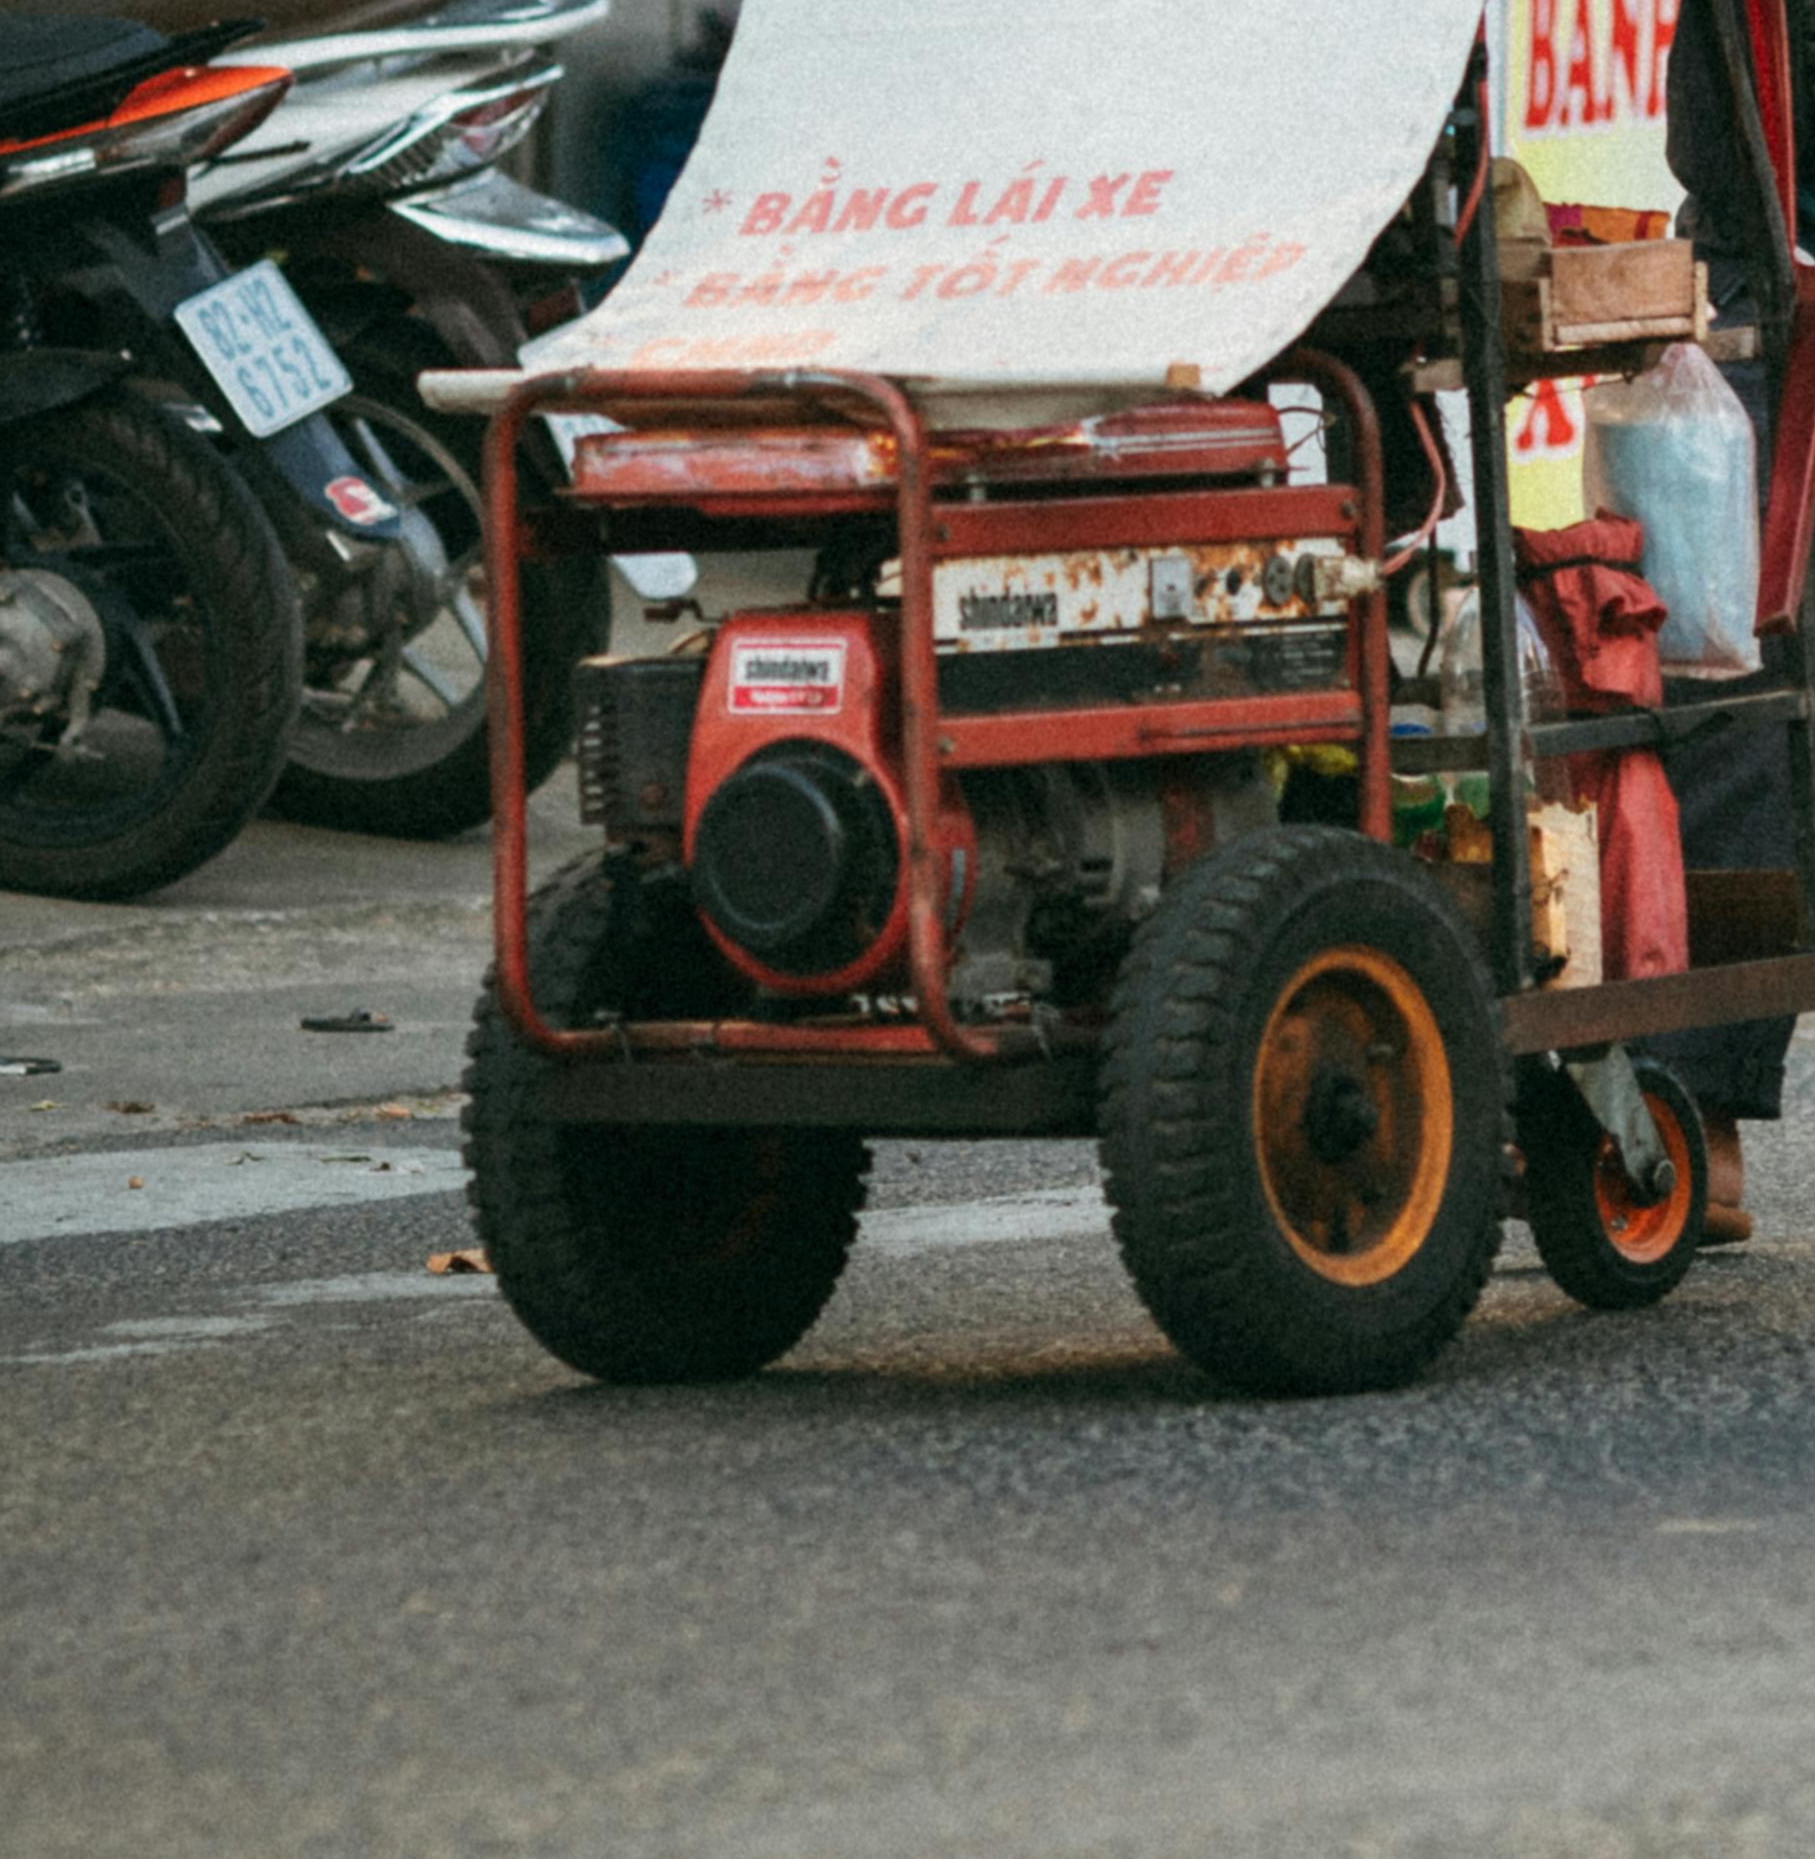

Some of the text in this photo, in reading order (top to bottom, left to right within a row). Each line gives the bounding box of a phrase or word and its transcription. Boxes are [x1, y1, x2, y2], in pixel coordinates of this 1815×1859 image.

[739, 156, 1174, 236] BẰNG LÁI XE
[236, 337, 332, 419] 6752
